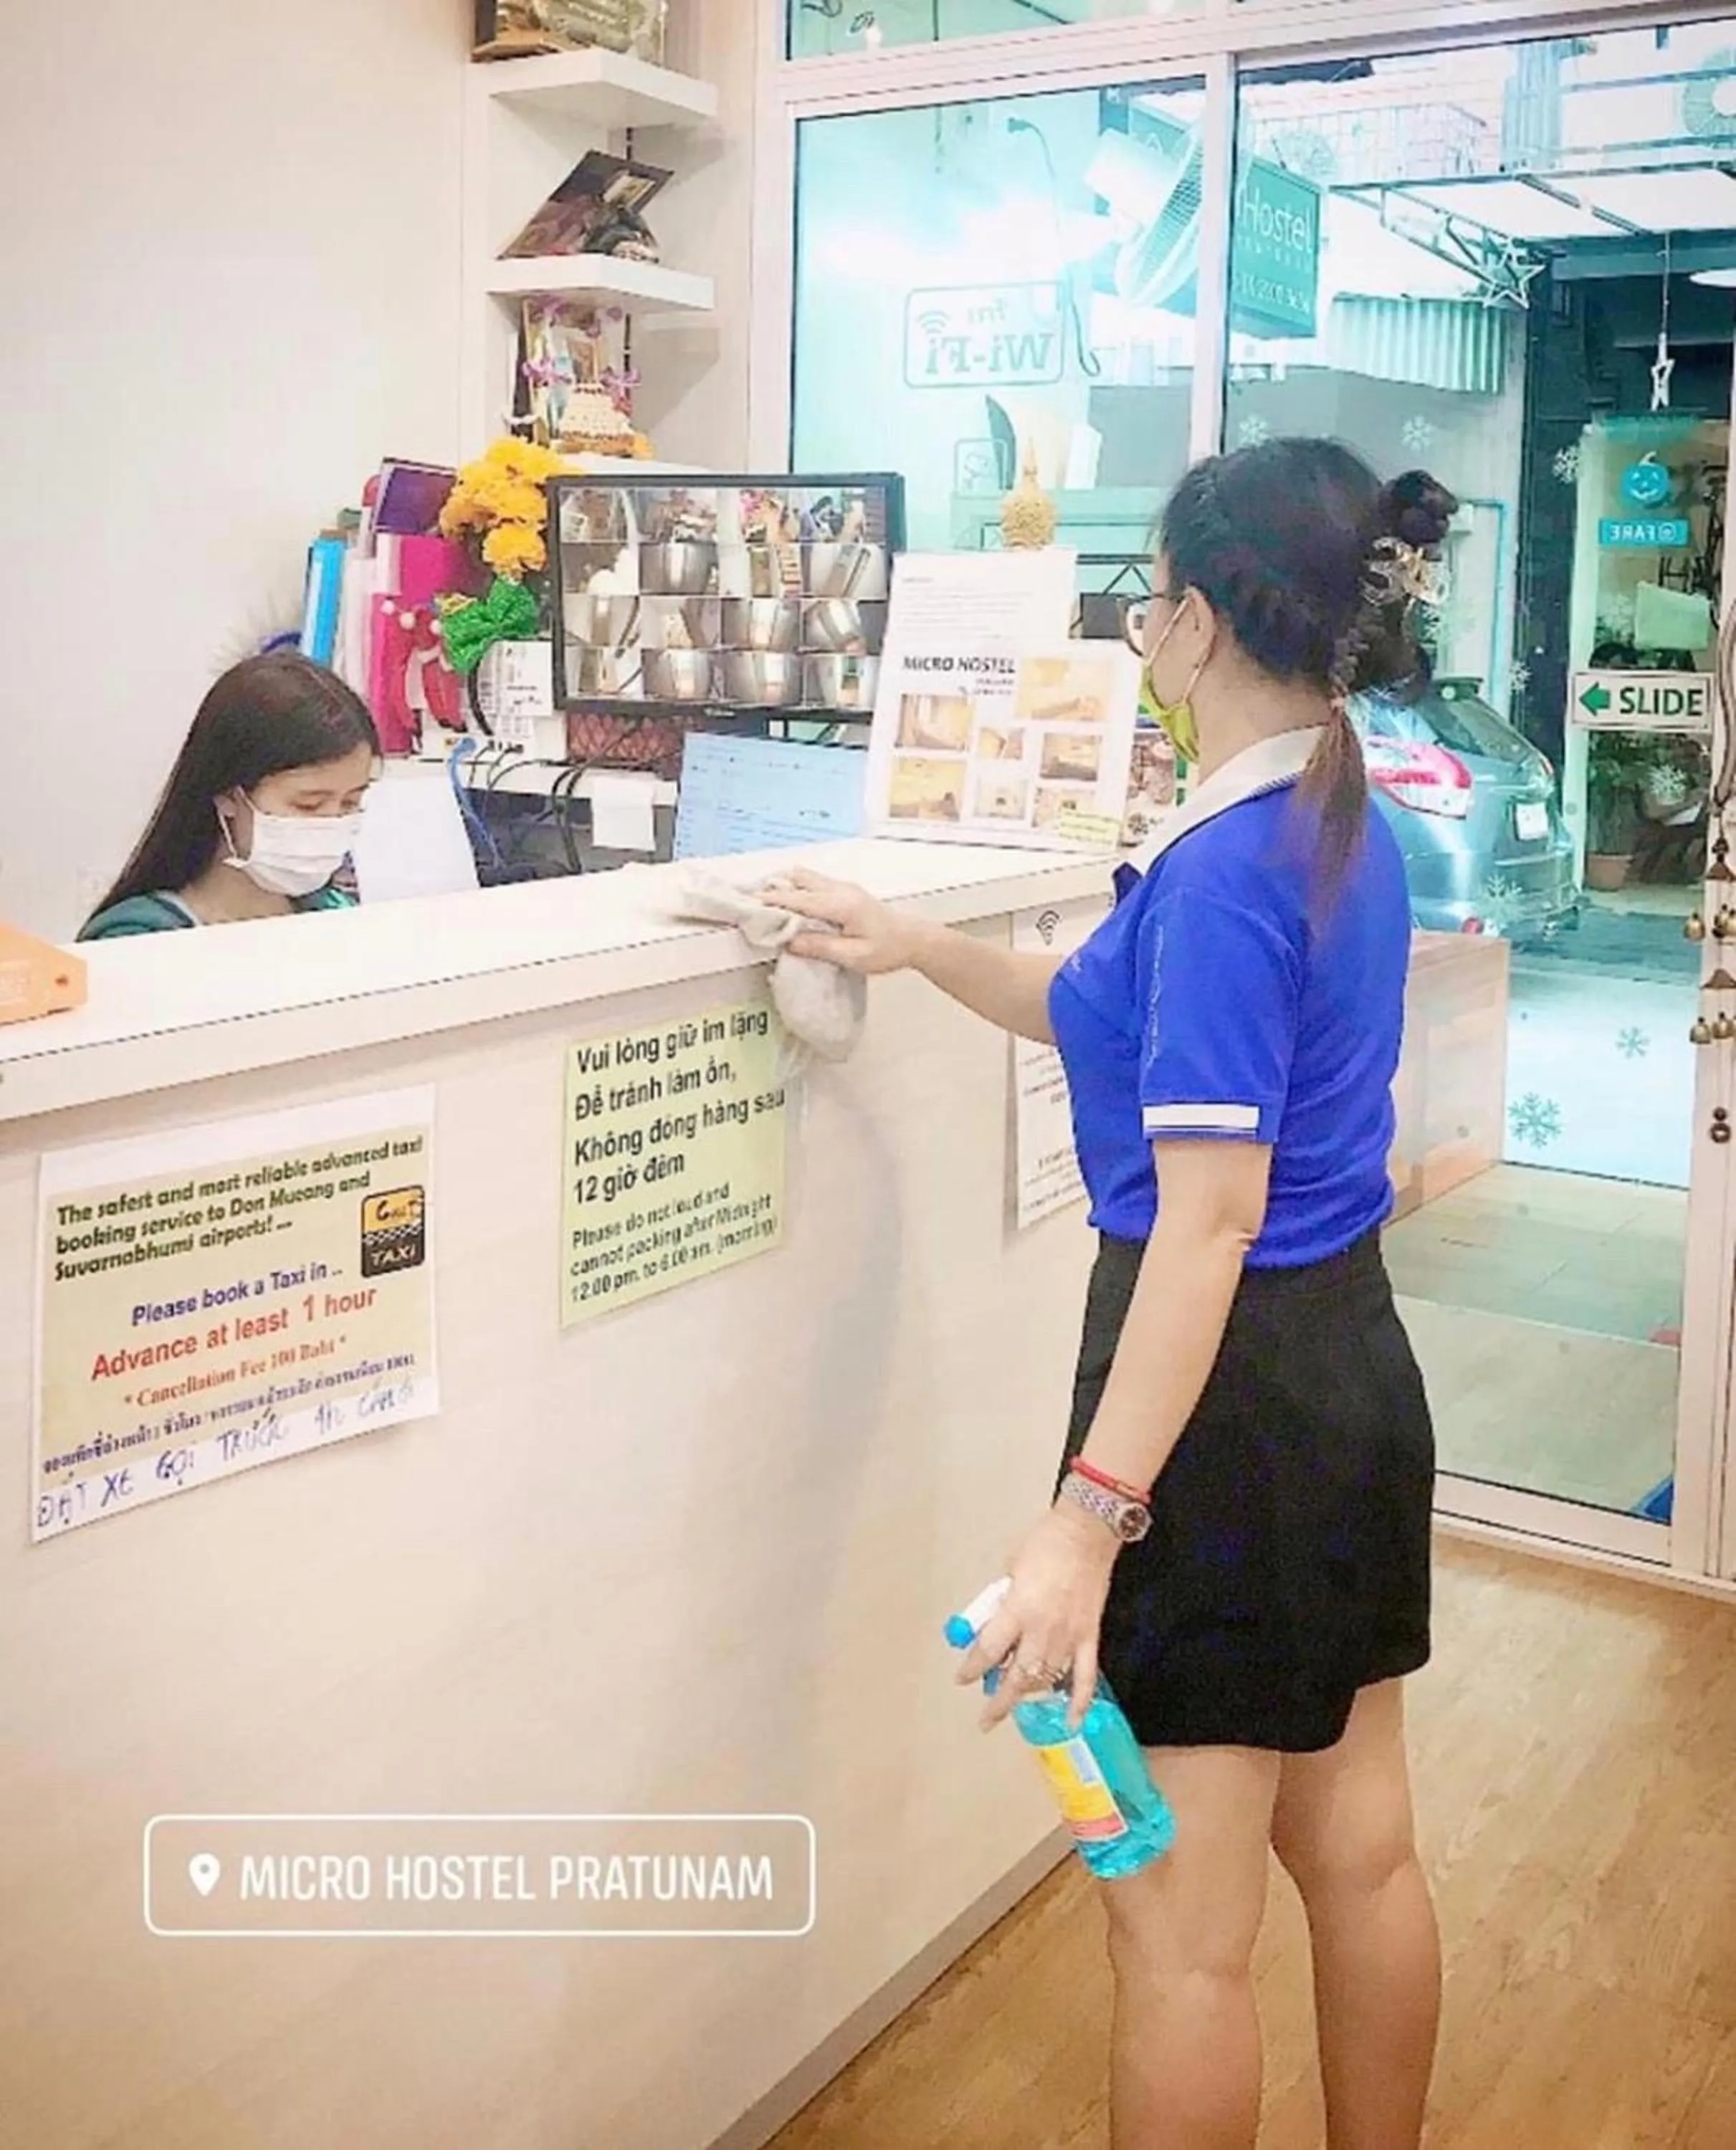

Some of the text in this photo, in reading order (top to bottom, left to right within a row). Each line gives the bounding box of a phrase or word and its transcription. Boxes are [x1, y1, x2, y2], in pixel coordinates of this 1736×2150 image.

[1242, 185, 1312, 254] Hostel
[902, 655, 954, 672] MICRO
[1619, 686, 1704, 716] SLIDE
[577, 1043, 609, 1074] Vui
[703, 1018, 725, 1043] im
[576, 1129, 642, 1166] Không
[754, 1089, 785, 1113] sau
[57, 1204, 92, 1226] The
[97, 1190, 153, 1218] safest
[157, 1181, 194, 1206] and
[198, 1174, 241, 1198] most
[244, 1160, 308, 1187] reliable
[312, 1141, 389, 1173] advanced
[574, 1175, 598, 1204] 12
[56, 1170, 371, 1255] booking service to Don Mueang and
[573, 1222, 621, 1249] Please
[626, 1213, 644, 1232] do
[647, 1205, 670, 1224] not
[54, 1233, 194, 1281] Suvarnabhumi
[371, 1243, 416, 1267] TAXI
[570, 1244, 623, 1276] cannot
[131, 1262, 327, 1327] Please book a Taxi in
[91, 1289, 377, 1381] Advance at least 1 hour
[136, 1367, 236, 1407] Cancellation
[241, 1360, 266, 1378] Fee
